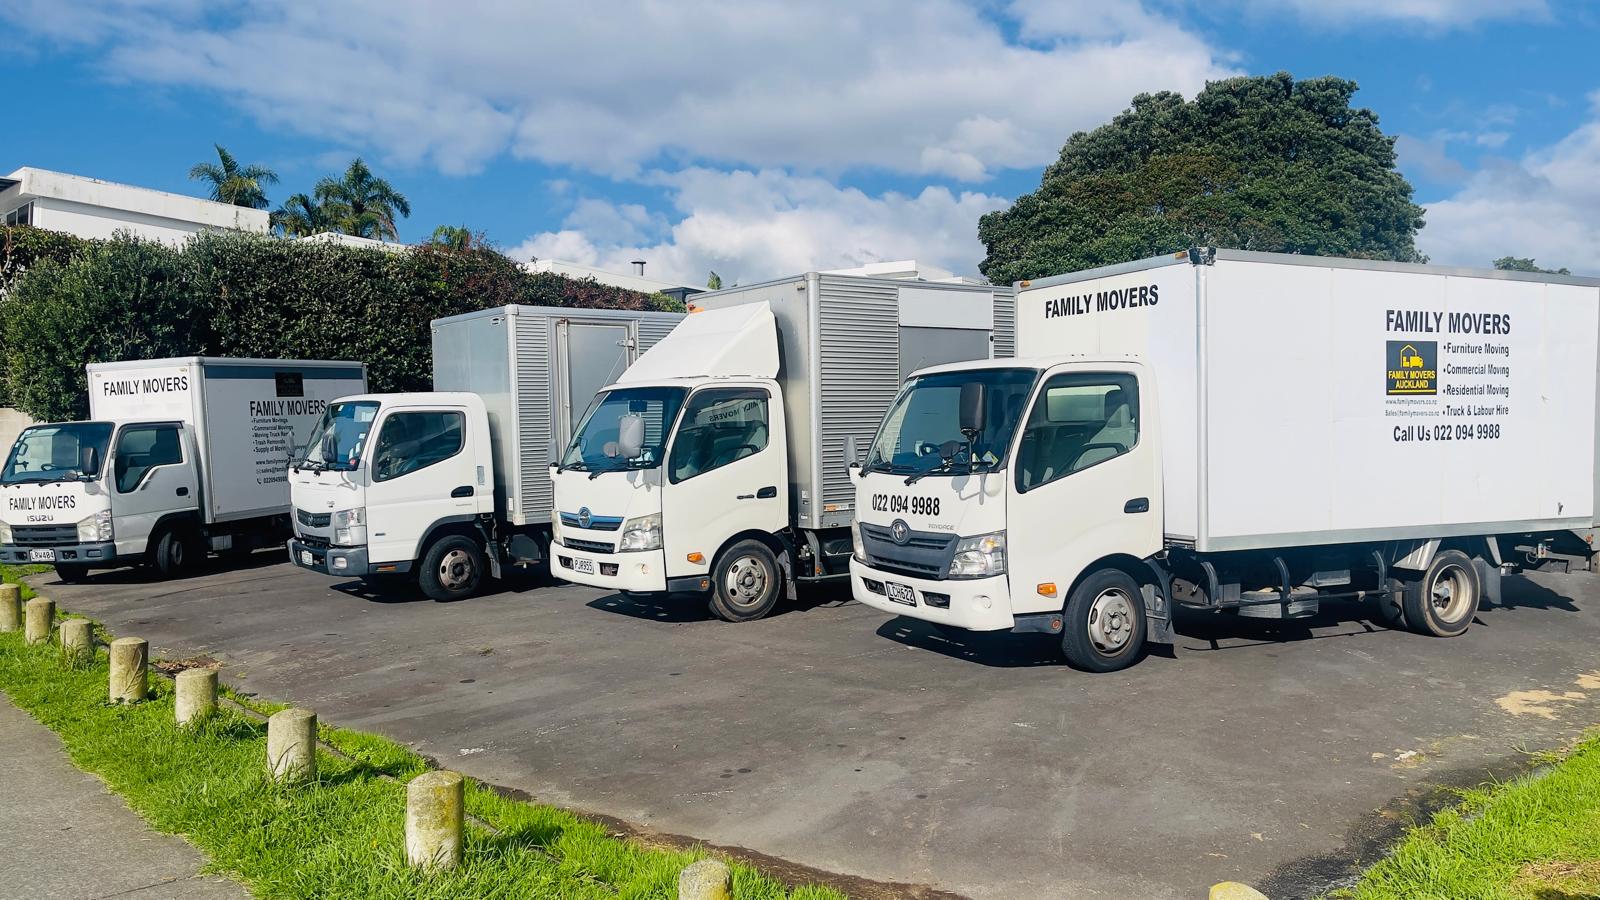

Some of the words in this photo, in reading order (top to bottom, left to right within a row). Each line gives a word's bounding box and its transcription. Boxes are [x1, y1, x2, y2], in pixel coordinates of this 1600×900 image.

[1045, 293, 1092, 318] FAMILY
[1096, 284, 1159, 312] MOVERS
[1386, 310, 1443, 333] FAMILY
[1448, 312, 1511, 335] MOVERS
[1446, 342, 1483, 354] Furniture
[1484, 343, 1510, 357] Moving
[1388, 370, 1409, 380] FAMILY
[1410, 370, 1436, 379] MOVERS
[1446, 363, 1486, 375] Commercial
[1487, 364, 1510, 378] Moving
[103, 380, 140, 396] FAMILY
[143, 376, 188, 393] MOVERS
[1395, 380, 1429, 389] AUCKLAND
[1446, 384, 1485, 396] Residential
[1487, 384, 1510, 398] Moving
[249, 401, 285, 416] FAMILY
[287, 400, 326, 416] MOVERS
[1446, 405, 1465, 416] Truck
[1467, 405, 1472, 416] &
[1473, 405, 1495, 416] Labour
[1496, 404, 1509, 416] Hire
[1393, 425, 1414, 442] Call
[1417, 425, 1431, 441] Us
[1434, 425, 1452, 441] 022
[1455, 424, 1474, 440] 094
[1477, 424, 1500, 440] 9988
[9, 497, 36, 511] FAMILY
[38, 495, 76, 510] MOVERS
[872, 493, 888, 511] 022
[891, 494, 909, 513] 094
[912, 496, 940, 516] 9988
[27, 514, 54, 522] ISUZU
